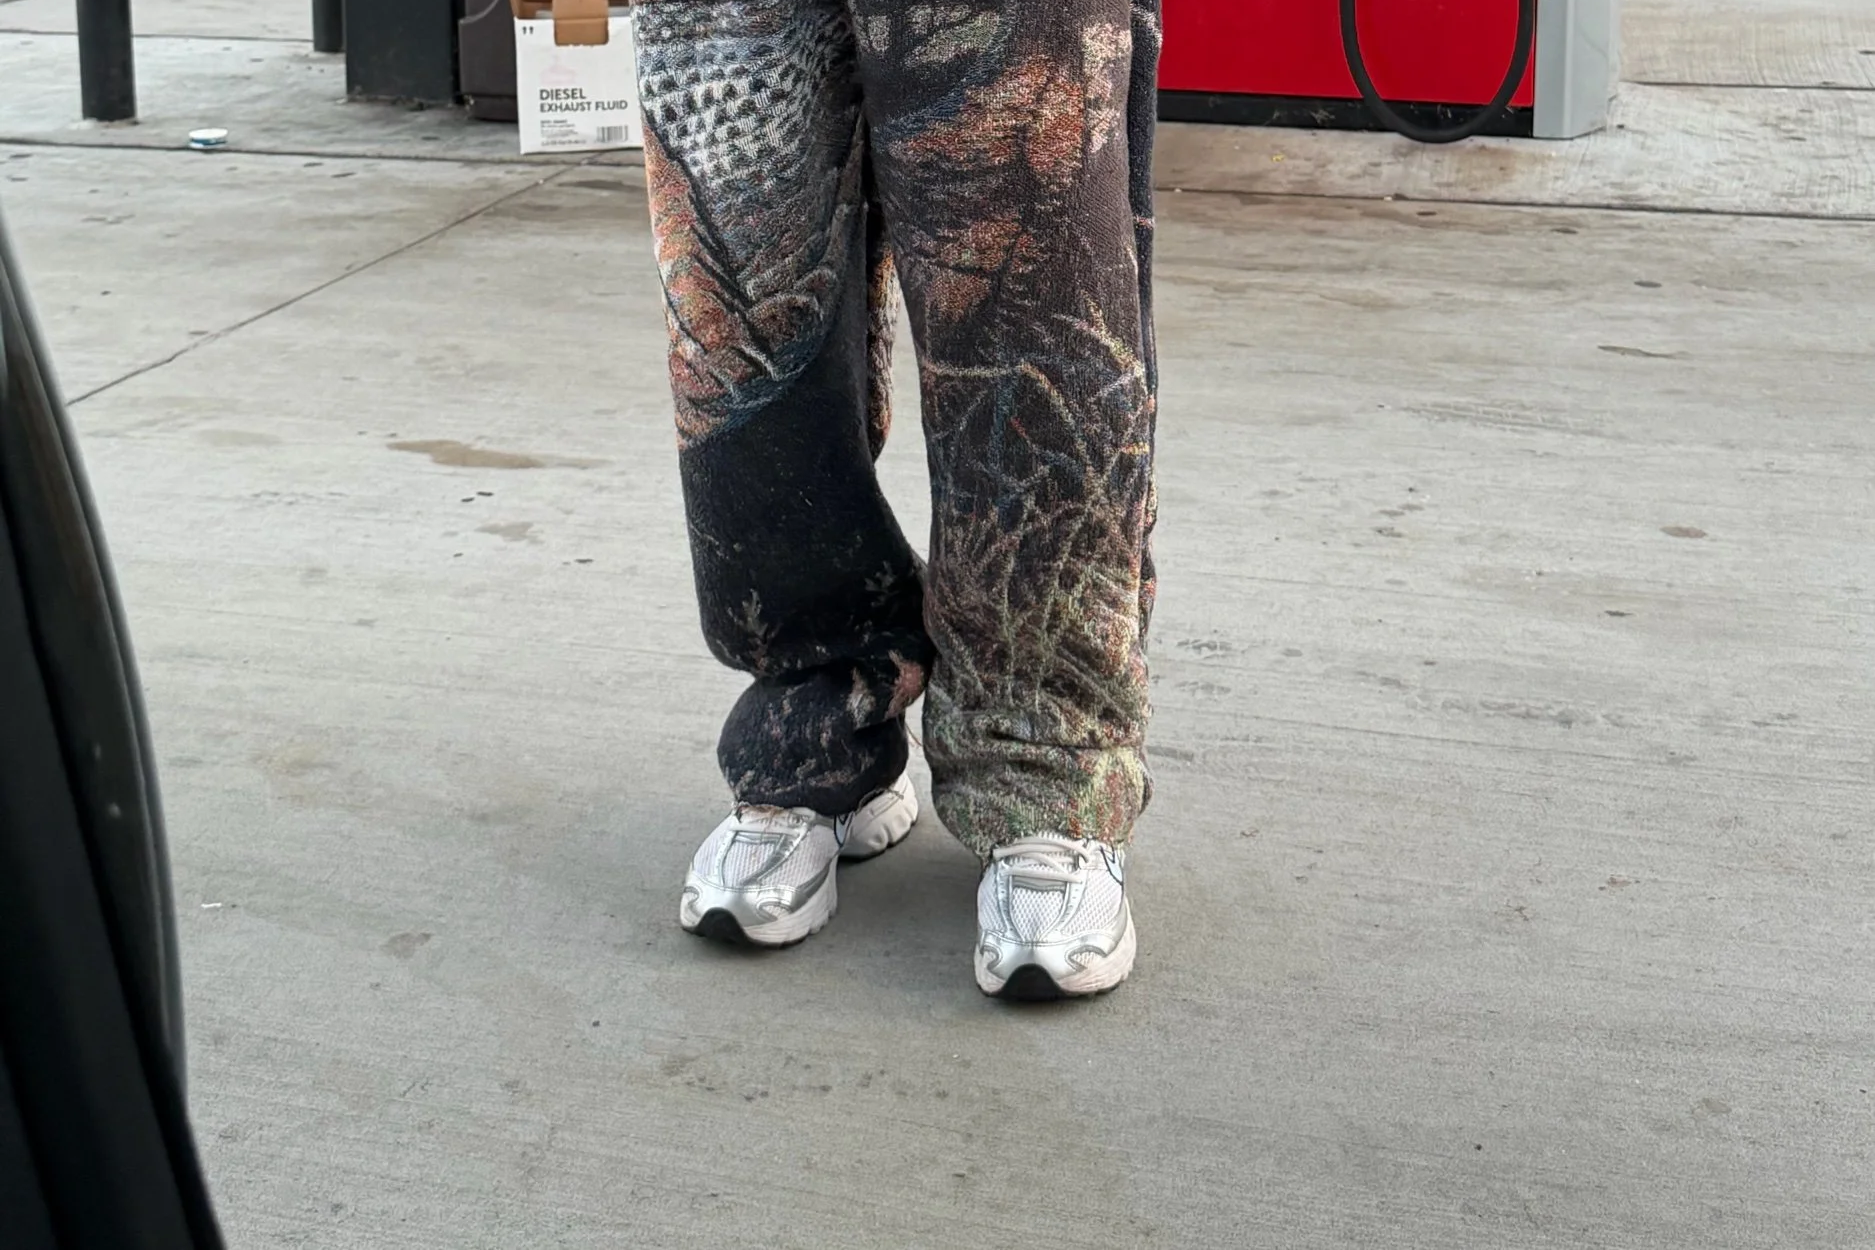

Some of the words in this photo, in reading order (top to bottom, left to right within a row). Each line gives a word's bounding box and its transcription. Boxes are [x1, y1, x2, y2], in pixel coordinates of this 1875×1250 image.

[540, 87, 587, 101] DIESEL
[539, 101, 592, 113] EXHAUST
[594, 99, 629, 111] FLUID
